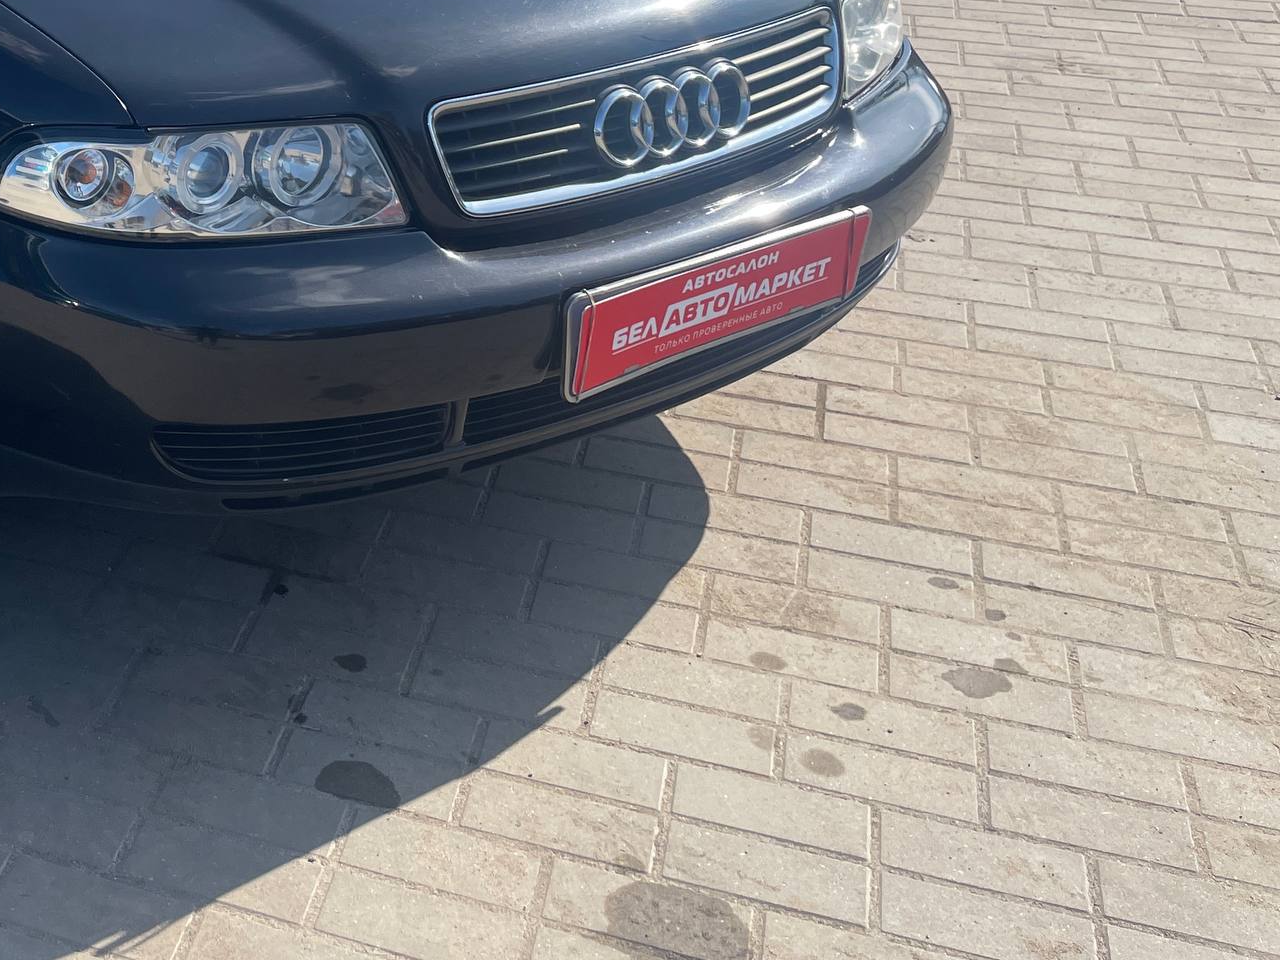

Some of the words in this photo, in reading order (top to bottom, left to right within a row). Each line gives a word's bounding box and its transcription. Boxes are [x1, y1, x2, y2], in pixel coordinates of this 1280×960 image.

[682, 251, 780, 294] АВТОСАЛОН
[612, 257, 832, 351] БЕЛАВТОМАРКЕТ
[654, 334, 690, 354] ТОЛЬКО
[692, 310, 758, 340] ПРОВЕРЕННЫЕ
[760, 302, 783, 317] АВТО
